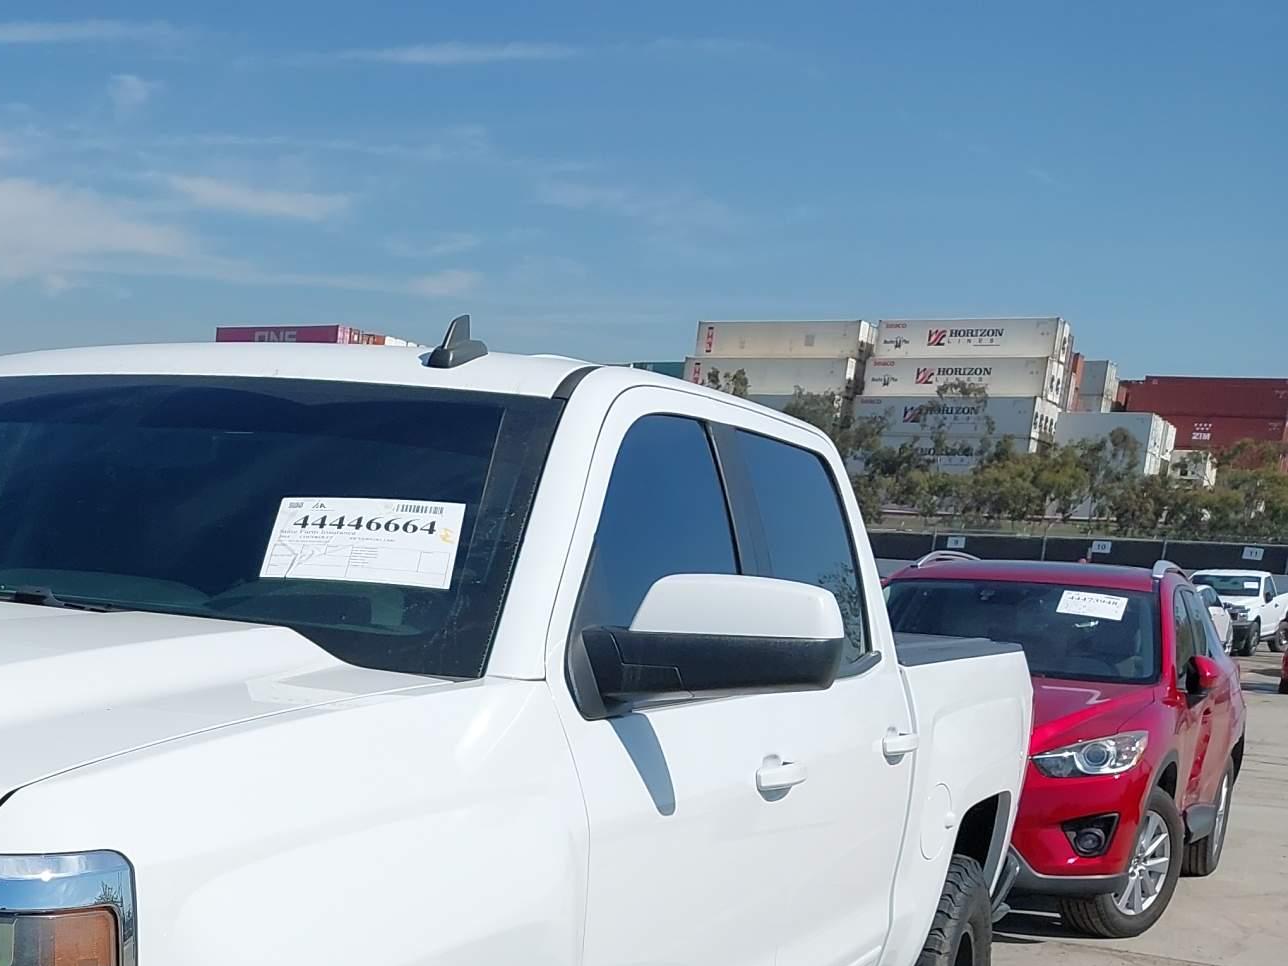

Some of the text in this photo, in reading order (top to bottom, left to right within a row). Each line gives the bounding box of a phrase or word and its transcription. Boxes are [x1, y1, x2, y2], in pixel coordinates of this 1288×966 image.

[254, 331, 297, 342] ONE
[949, 328, 1004, 338] HORIZON
[936, 367, 992, 376] HORIZON
[1191, 432, 1211, 441] ZIM
[293, 515, 437, 535] 44446664
